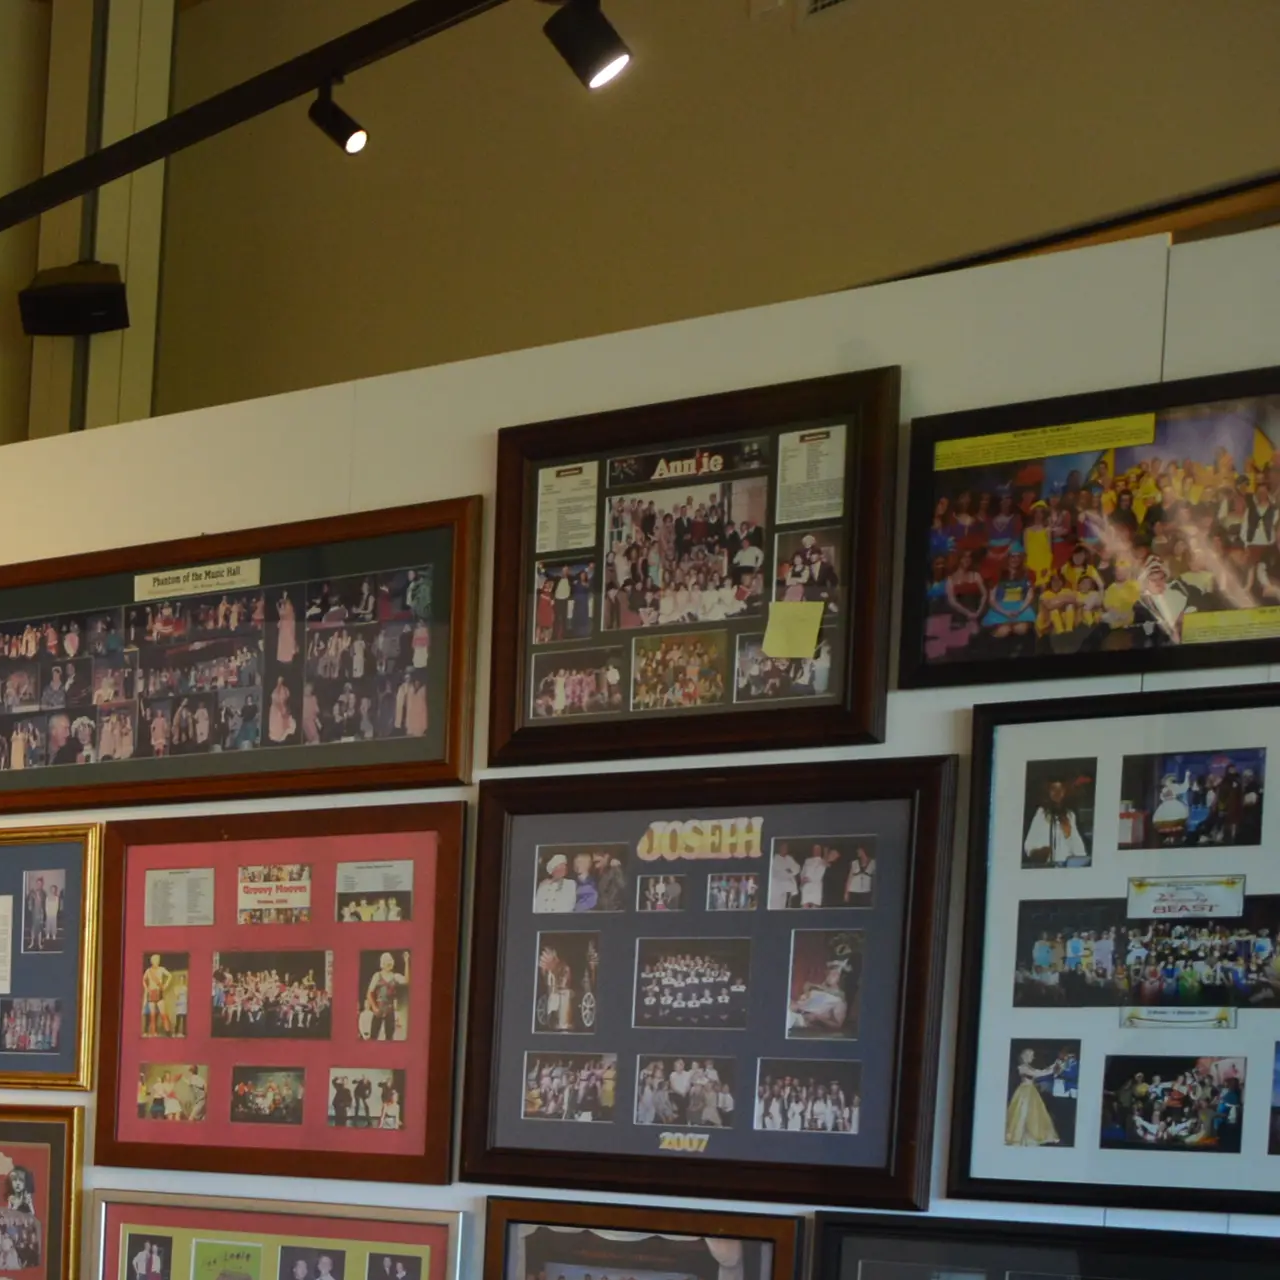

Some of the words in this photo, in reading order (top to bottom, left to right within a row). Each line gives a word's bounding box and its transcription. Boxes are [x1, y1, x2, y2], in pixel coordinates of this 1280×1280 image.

[650, 451, 724, 479] Annie
[152, 575, 181, 588] Phantom
[182, 571, 190, 583] of
[192, 571, 203, 581] the
[204, 569, 225, 580] Music
[226, 566, 241, 577] Hall
[636, 816, 764, 861] JOSEPH
[1152, 904, 1215, 914] BEAST
[659, 1131, 710, 1152] 2007
